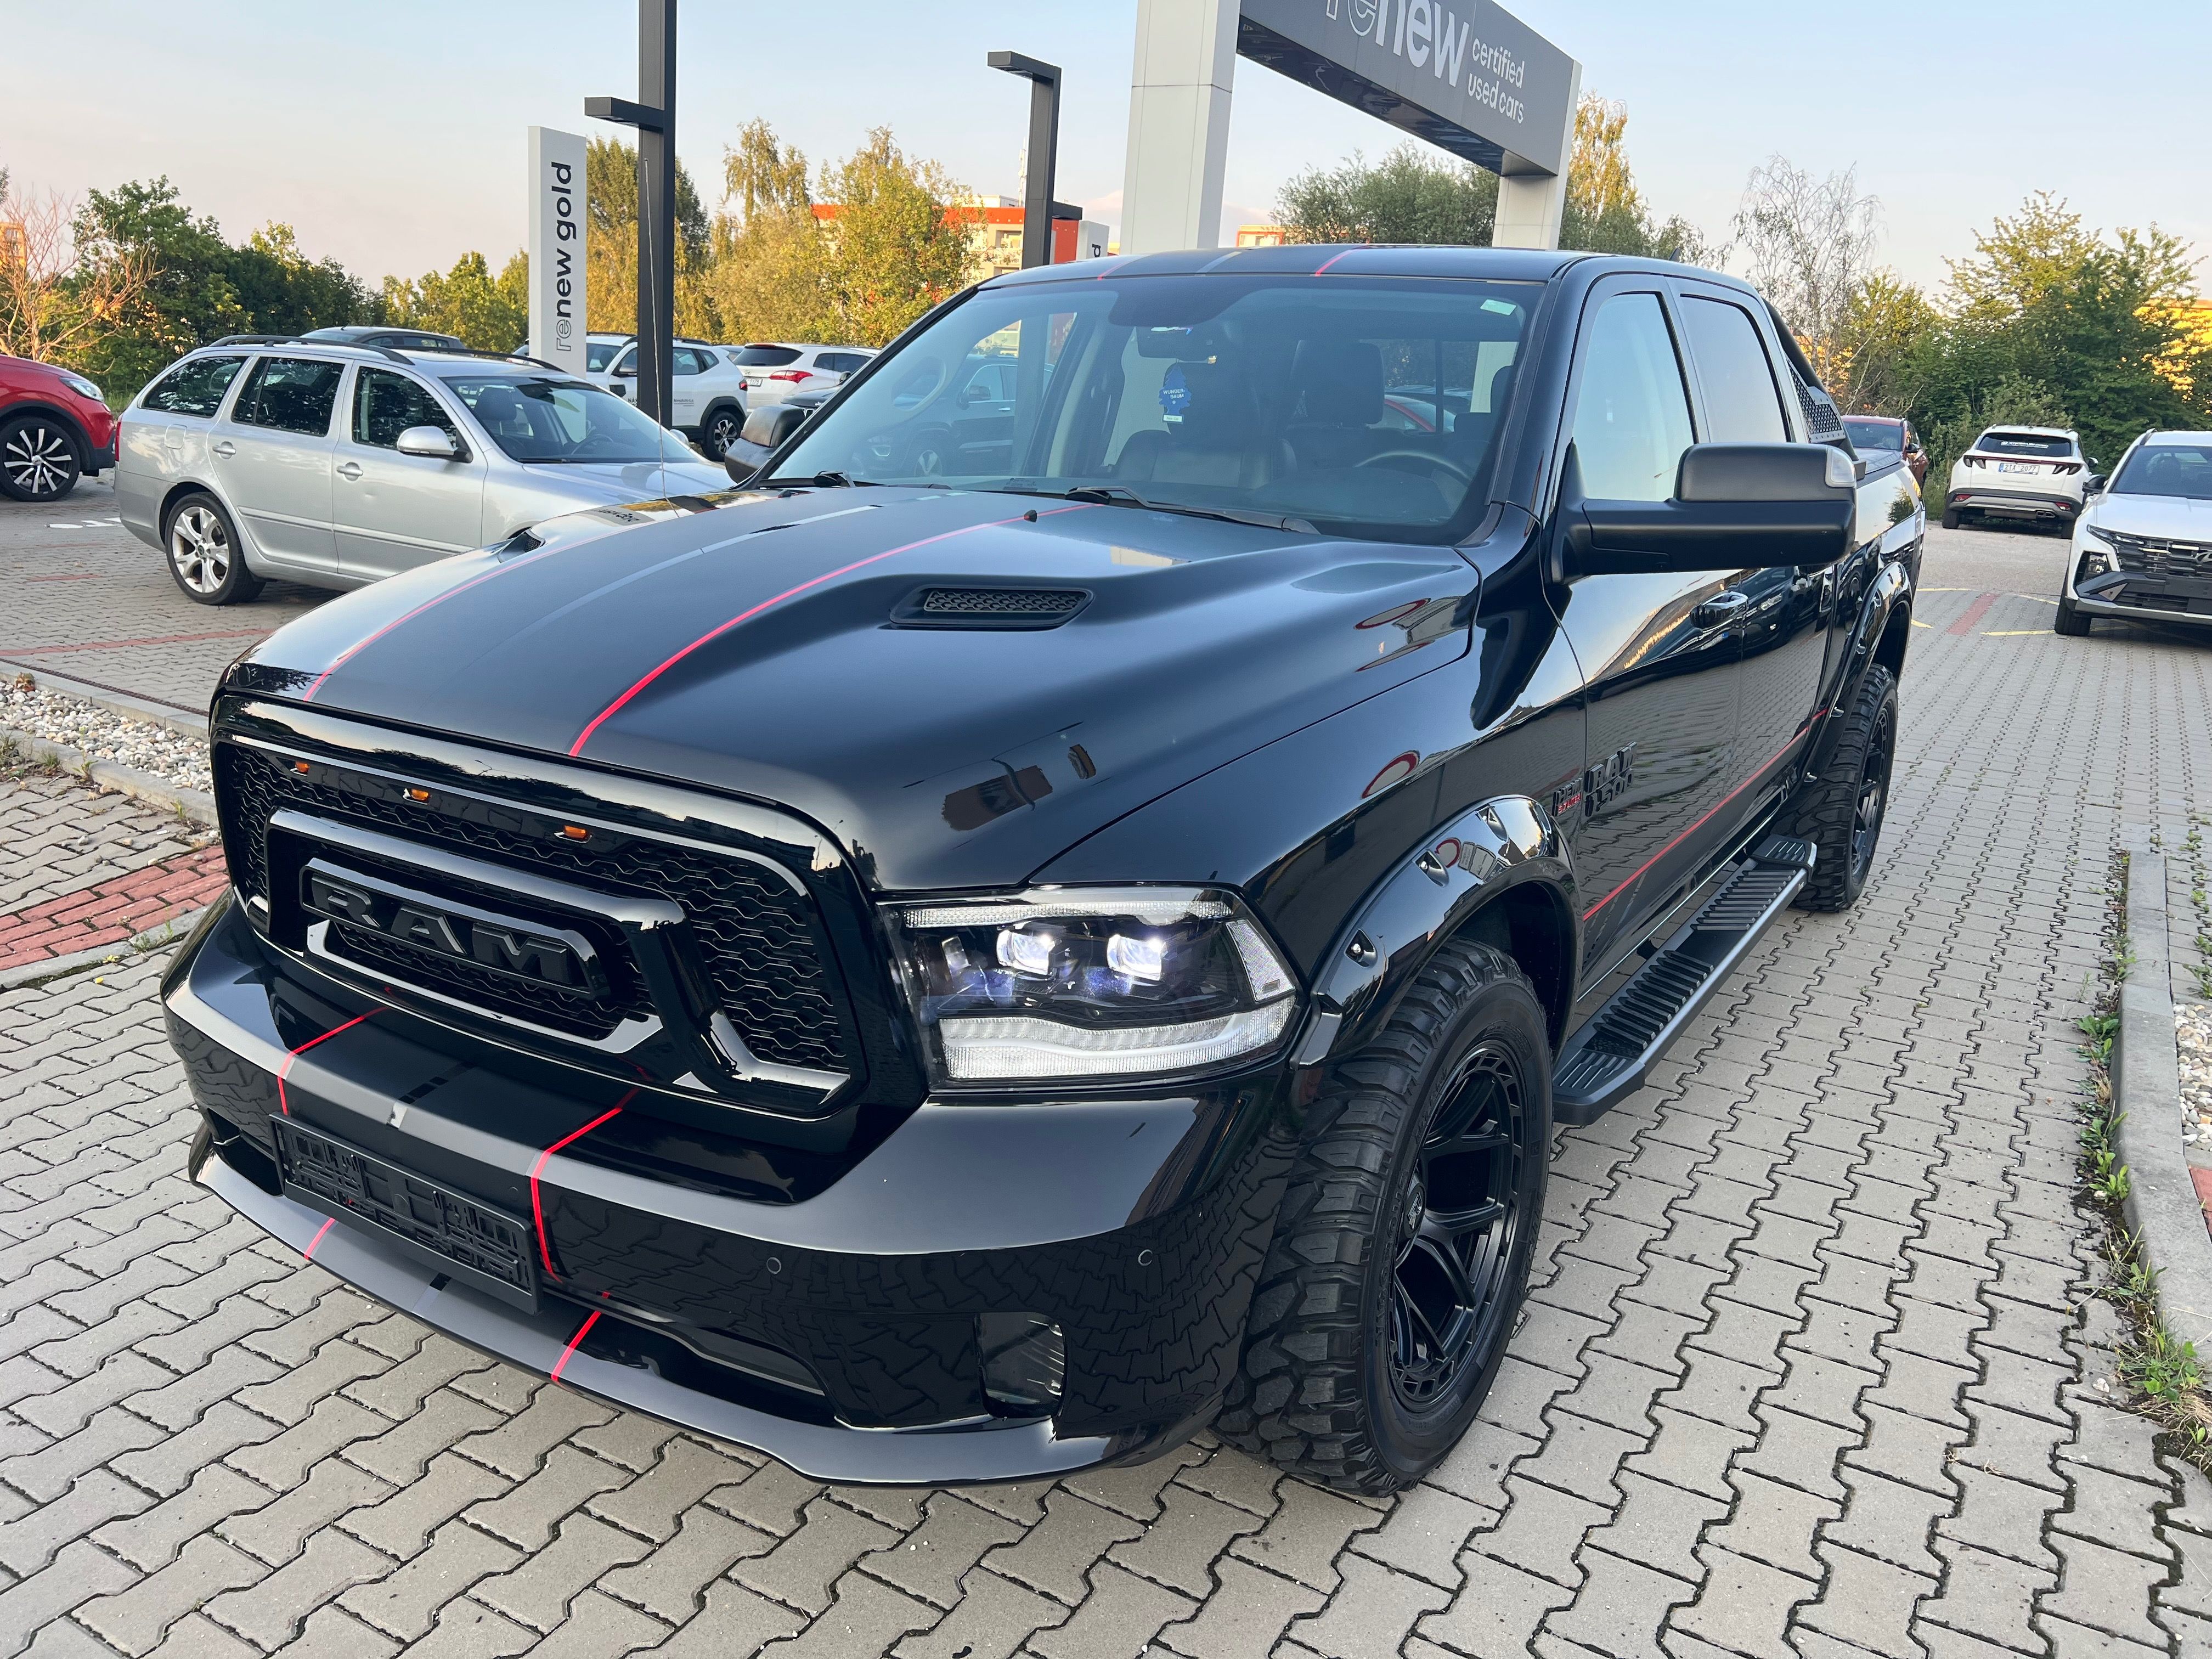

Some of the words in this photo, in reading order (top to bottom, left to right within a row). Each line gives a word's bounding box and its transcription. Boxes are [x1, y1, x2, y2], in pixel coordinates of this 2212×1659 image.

[1472, 38, 1525, 89] certified
[1468, 73, 1499, 109] used
[1499, 92, 1524, 124] cars
[551, 161, 577, 241] gold
[556, 249, 572, 352] renew
[1584, 741, 1637, 793] RAM
[1585, 768, 1634, 816] 1500
[311, 877, 572, 984] RAM
